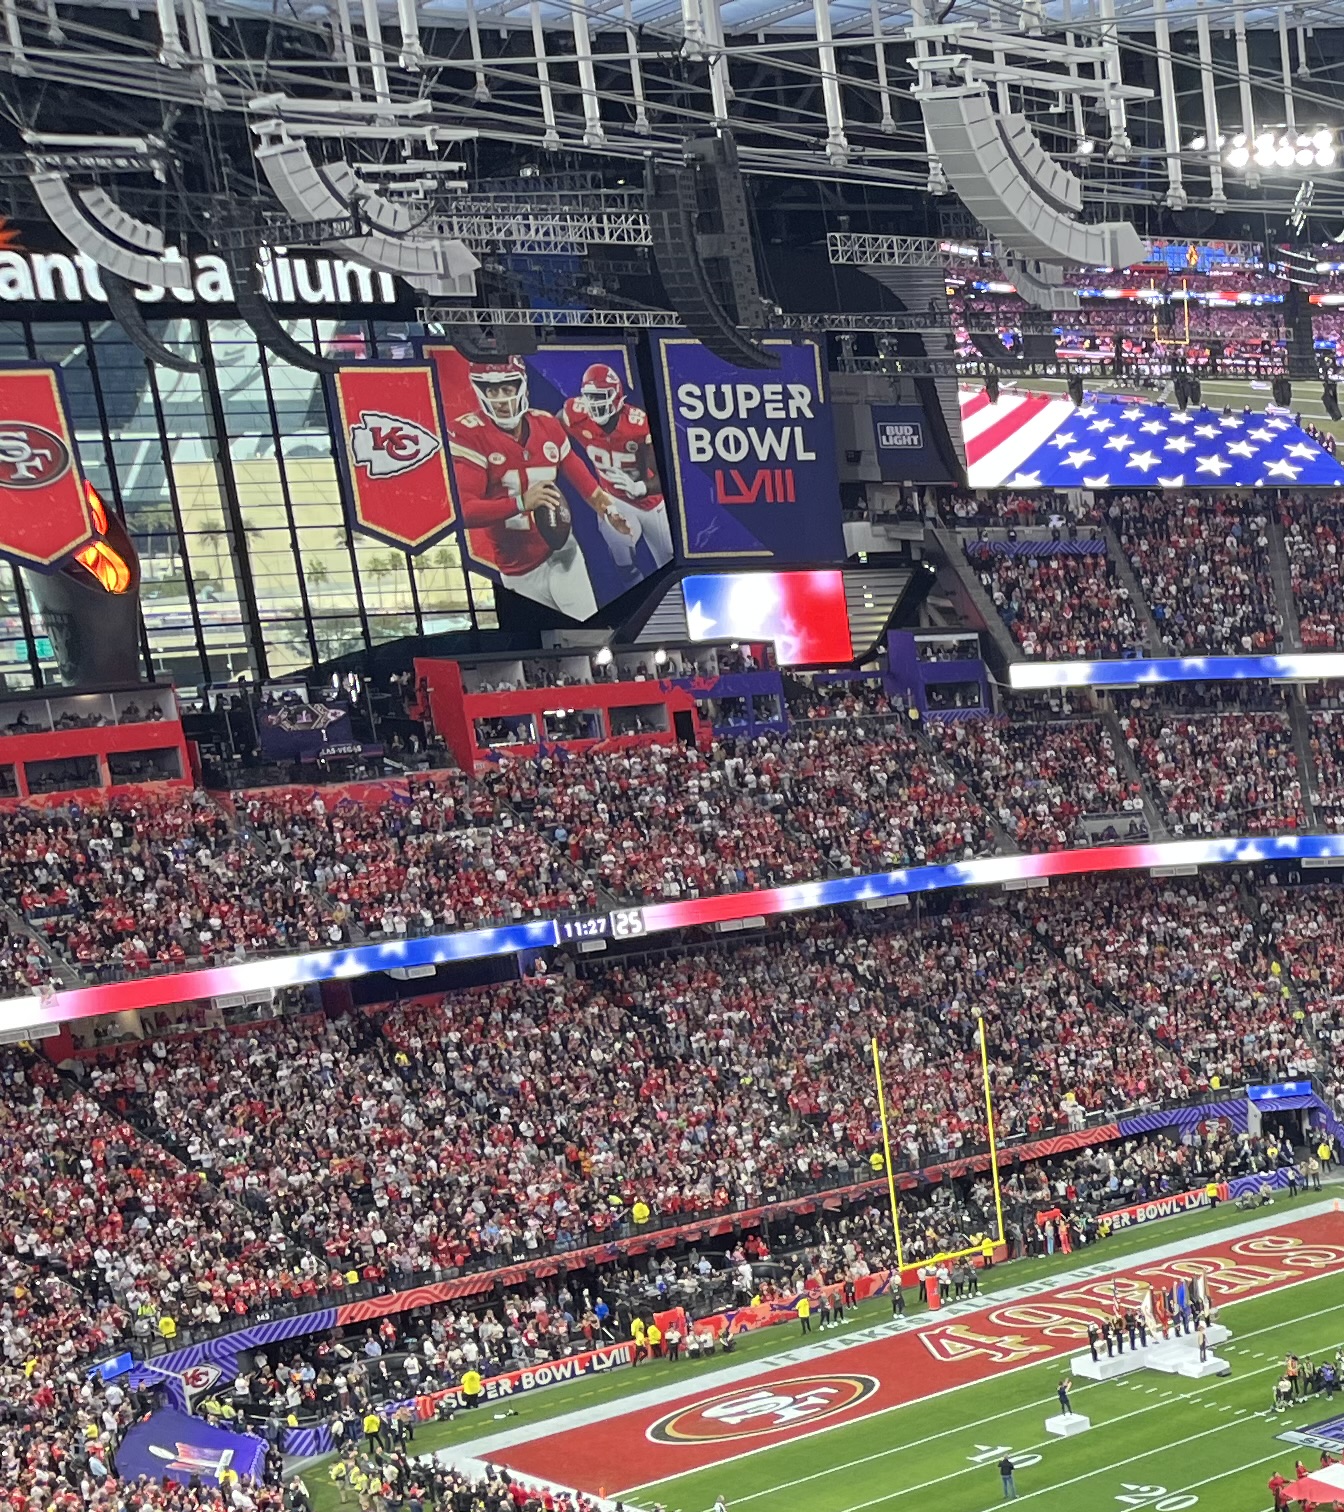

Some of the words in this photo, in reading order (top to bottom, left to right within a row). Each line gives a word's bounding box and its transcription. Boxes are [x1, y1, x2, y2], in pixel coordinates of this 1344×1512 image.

[677, 383, 814, 420] SUPER
[686, 426, 816, 463] BOWL
[881, 435, 919, 446] LIGHT
[885, 425, 913, 436] BUD
[714, 468, 796, 504] LVIII
[563, 918, 607, 938] 11:27
[617, 911, 642, 935] 25
[1098, 1212, 1131, 1230] PER
[1136, 1200, 1180, 1223] BOWL
[757, 1354, 800, 1368] IT
[808, 1317, 932, 1352] TAKES
[938, 1294, 1013, 1317] ALL
[1017, 1278, 1066, 1293] OF
[1075, 1264, 1116, 1279] US
[522, 1360, 586, 1391] BOWL
[592, 1345, 630, 1371] LVIII
[967, 1445, 1043, 1469] 10
[1115, 1485, 1199, 1512] 20
